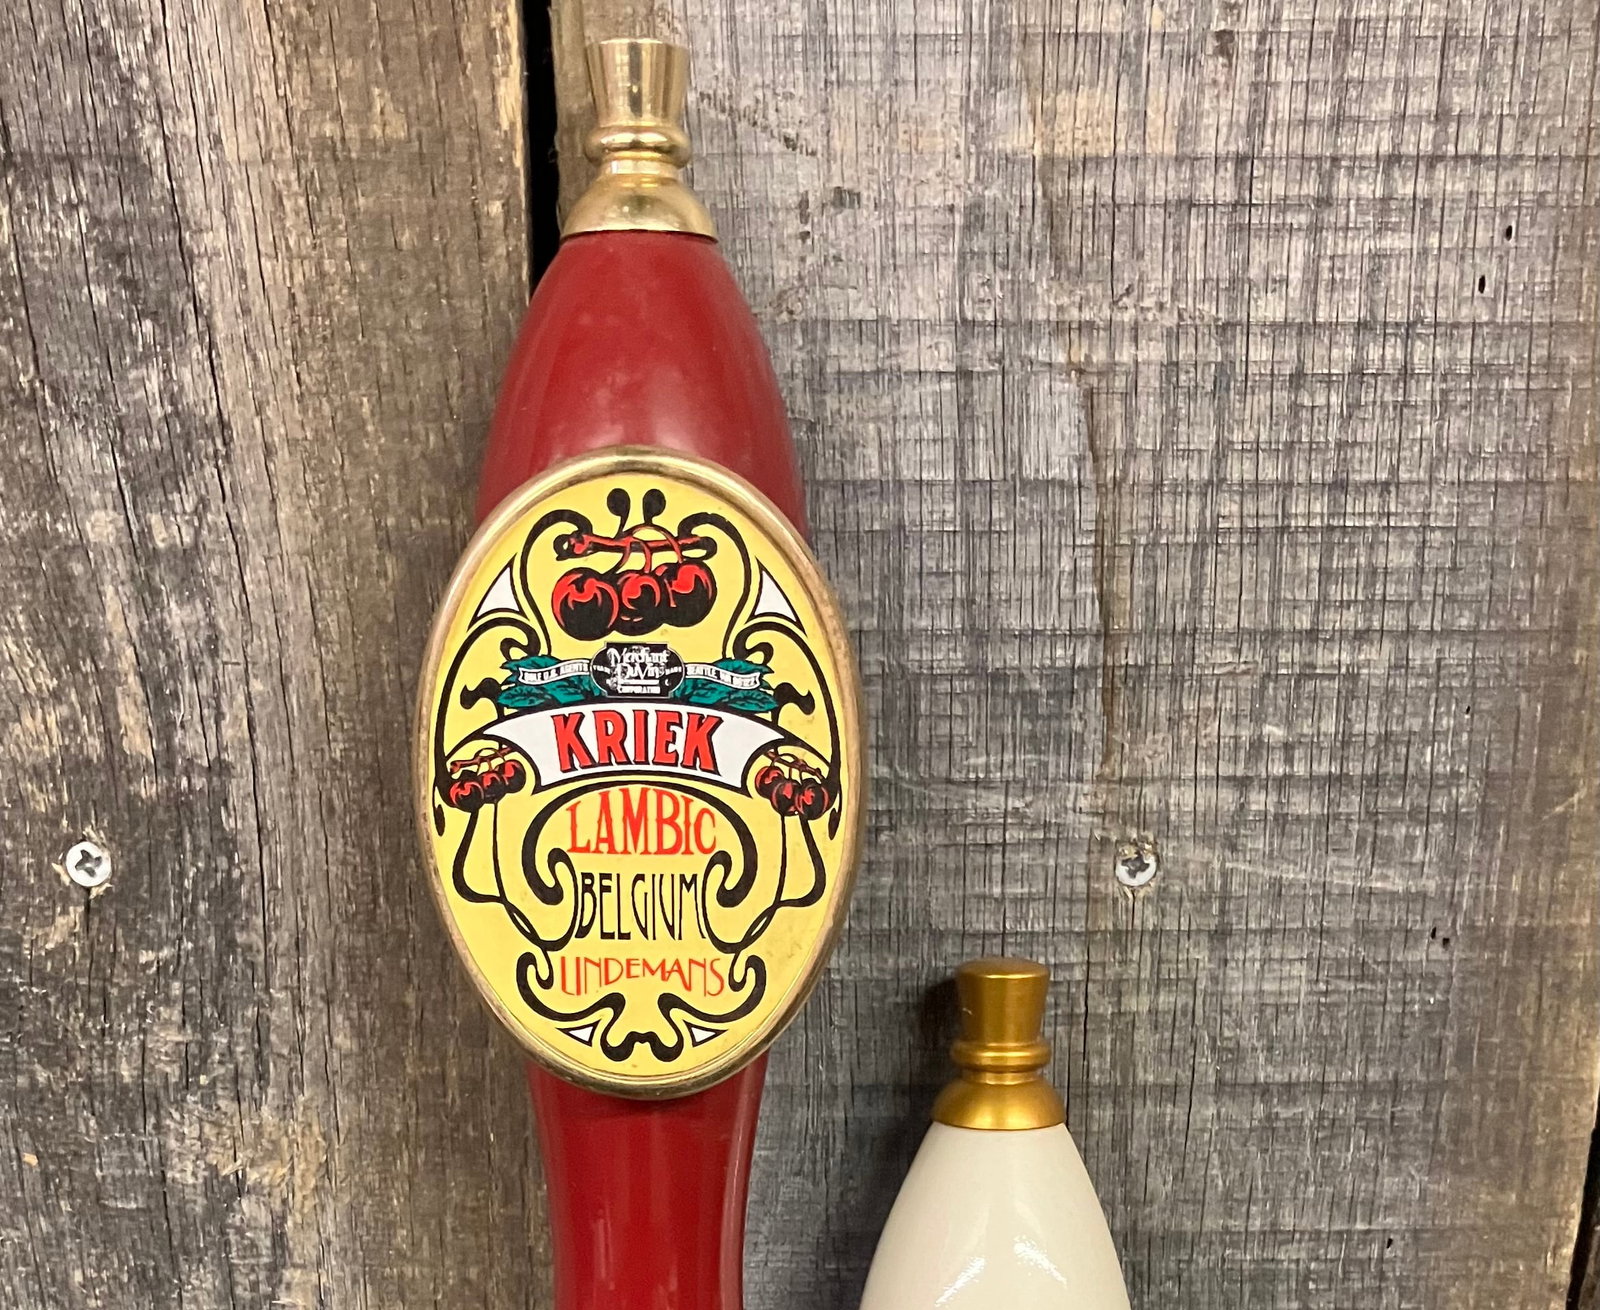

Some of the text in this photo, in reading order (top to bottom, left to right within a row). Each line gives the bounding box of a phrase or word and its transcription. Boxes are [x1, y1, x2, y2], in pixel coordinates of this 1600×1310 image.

[551, 710, 724, 776] KRIEK
[566, 787, 717, 856] LAMBIC
[574, 872, 706, 941] BELGIUM
[560, 955, 725, 998] LINDEMANS
